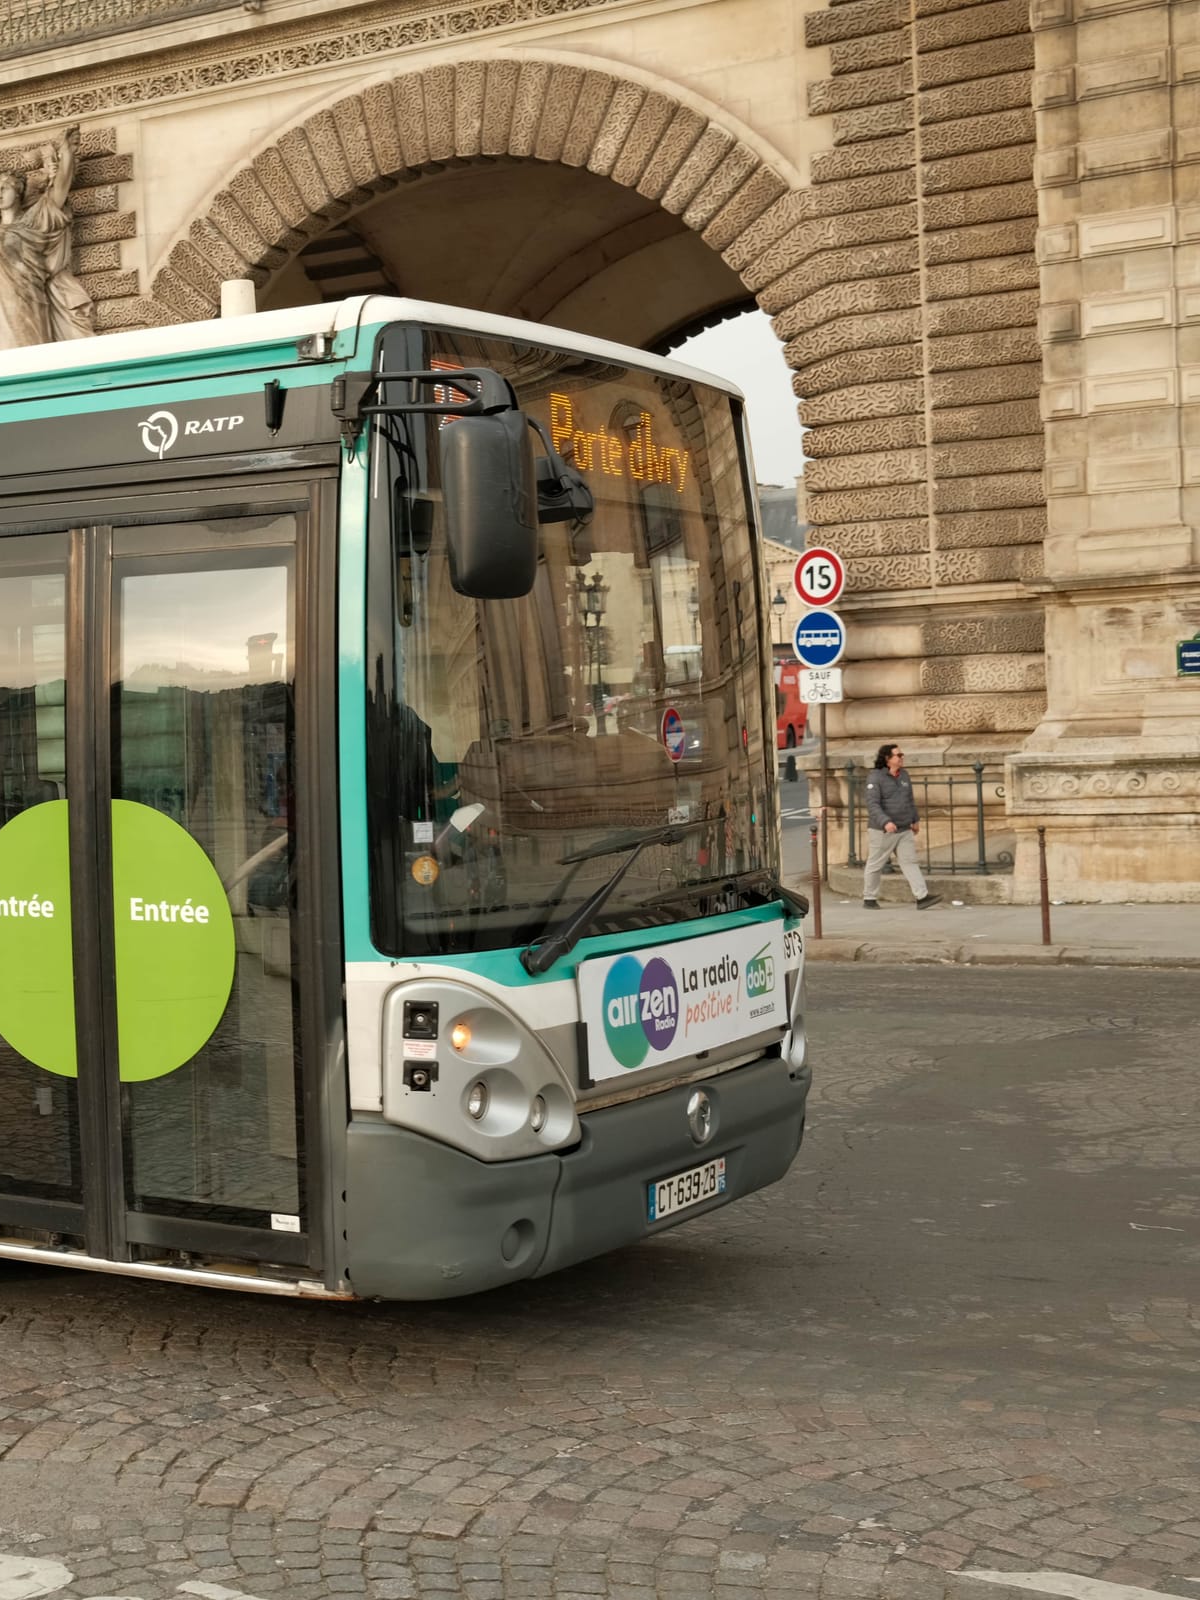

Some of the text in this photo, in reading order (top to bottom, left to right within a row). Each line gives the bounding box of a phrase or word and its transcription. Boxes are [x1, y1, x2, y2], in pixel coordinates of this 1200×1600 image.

[184, 415, 244, 435] RATP
[550, 392, 623, 475] Porte
[805, 565, 832, 590] 15
[809, 671, 831, 681] SAUF
[130, 897, 209, 924] Entrée
[783, 930, 803, 960] 973
[681, 954, 739, 994] La radio
[655, 1018, 675, 1031] Radio
[684, 985, 732, 1038] positive
